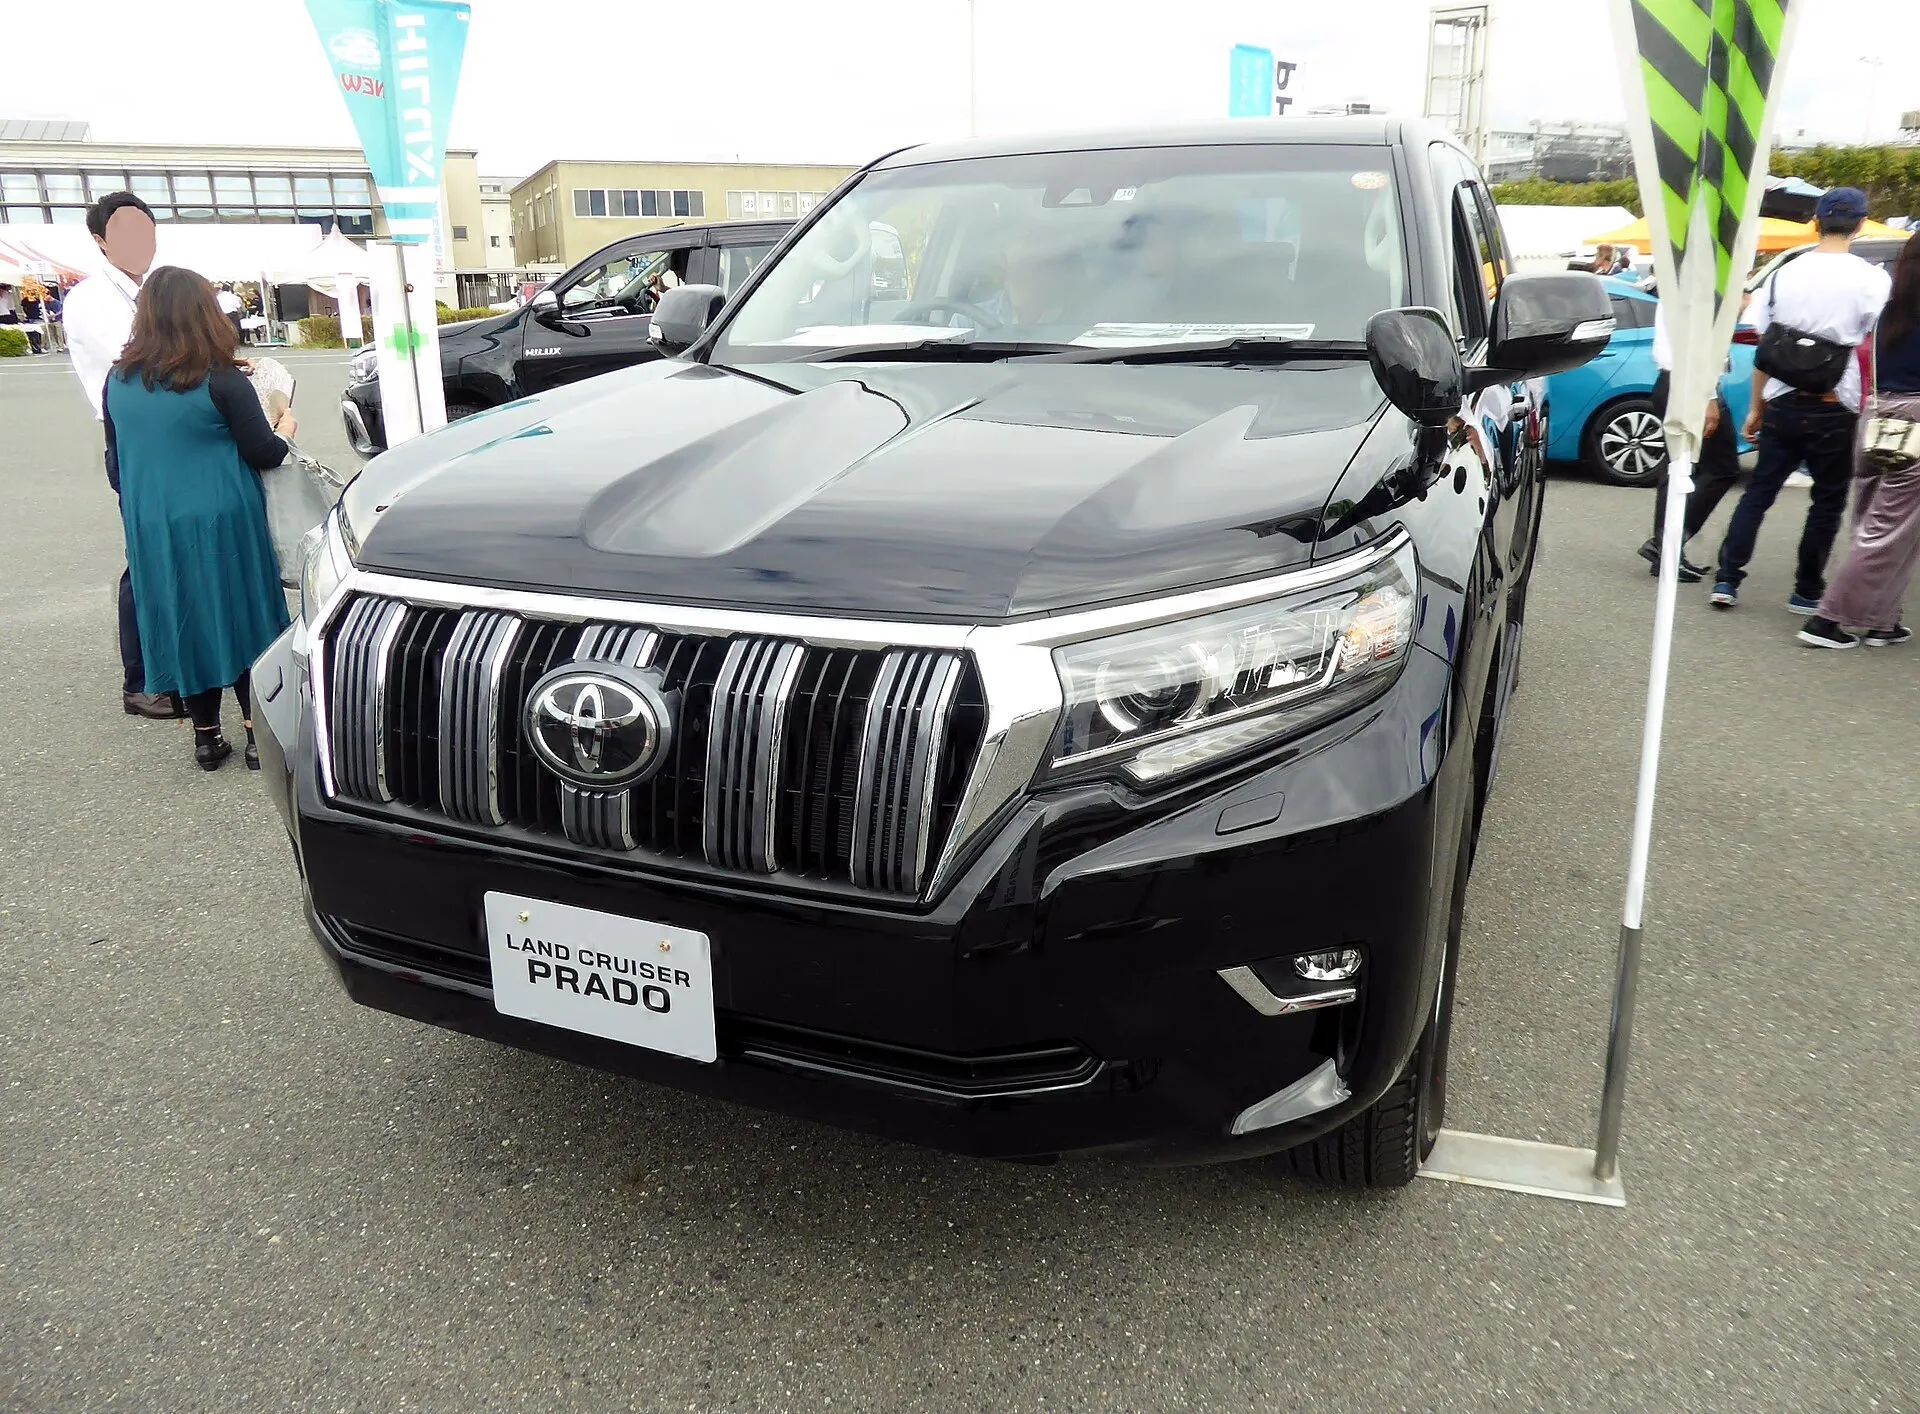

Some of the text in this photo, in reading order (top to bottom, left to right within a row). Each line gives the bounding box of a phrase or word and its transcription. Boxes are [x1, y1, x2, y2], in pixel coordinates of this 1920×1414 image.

[395, 14, 435, 184] HILUX
[525, 347, 562, 357] HILUX
[506, 933, 691, 988] LAND CRUISER
[528, 958, 671, 1014] PRADO
